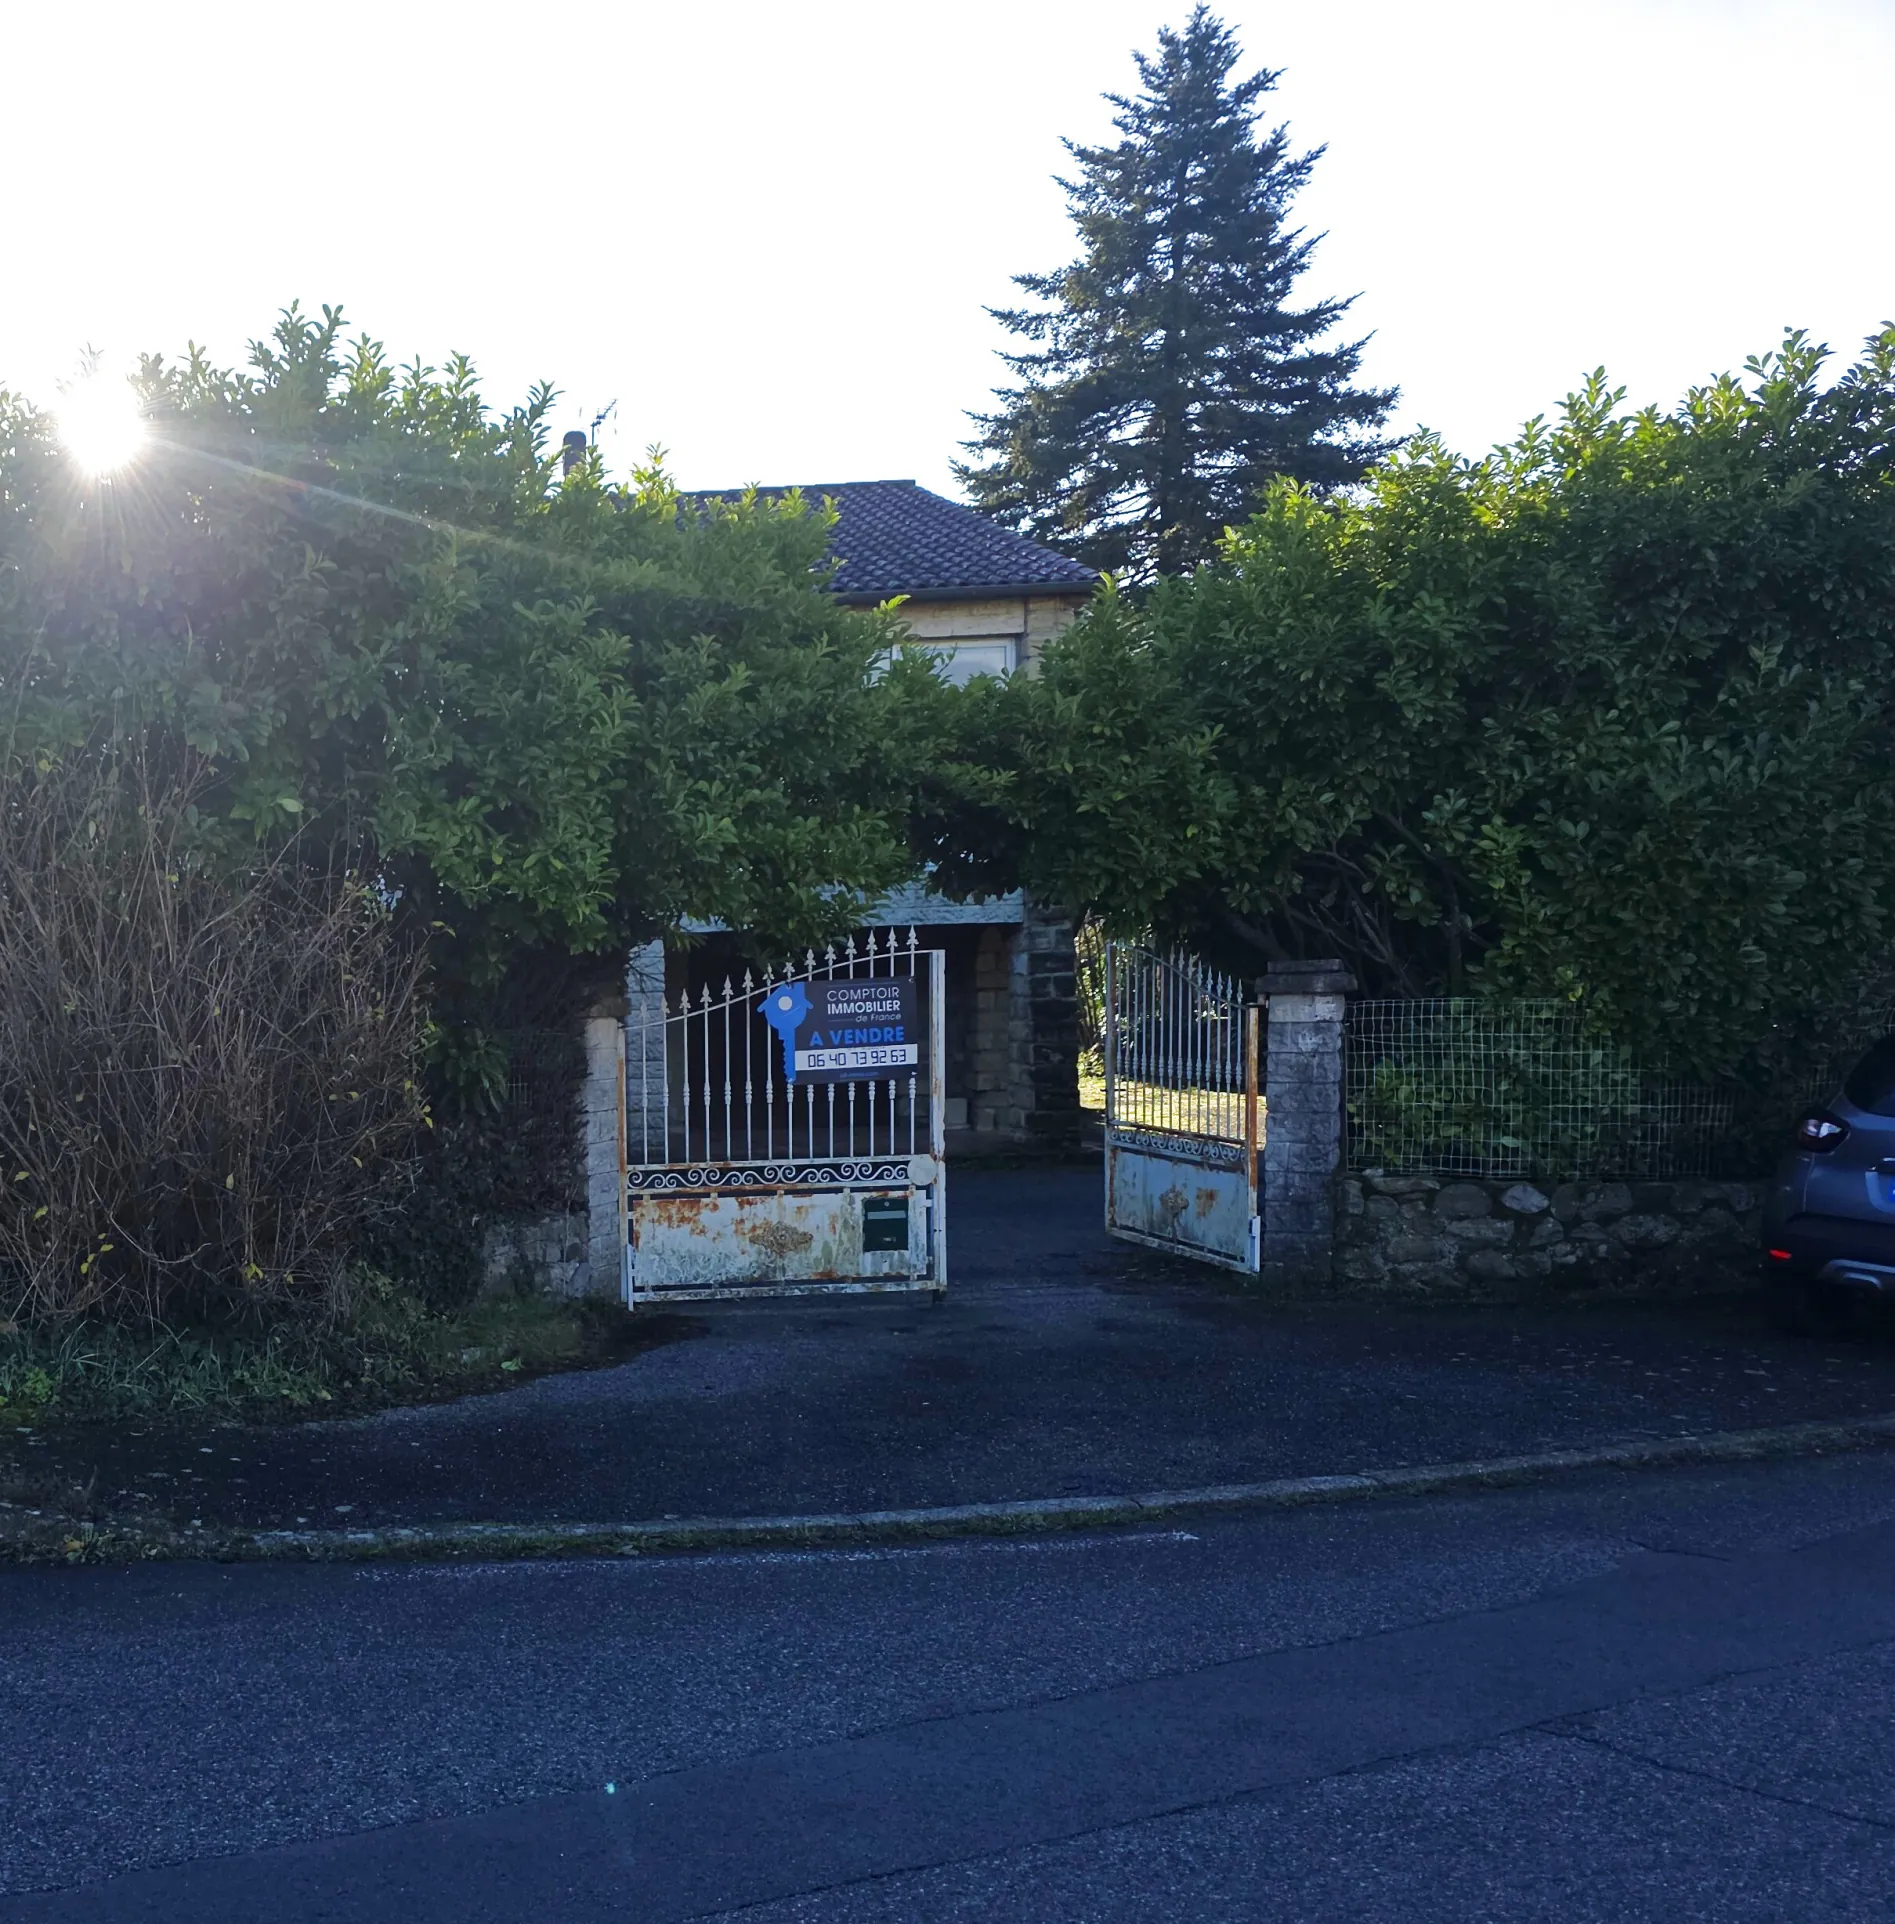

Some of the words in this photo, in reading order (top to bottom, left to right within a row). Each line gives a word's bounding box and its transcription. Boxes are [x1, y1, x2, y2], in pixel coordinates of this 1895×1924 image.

[827, 987, 900, 1001] COMPTOIR
[827, 1000, 901, 1015] IMMOBILIER
[855, 1013, 868, 1023] de
[871, 1013, 901, 1021] France
[810, 1031, 824, 1046] A
[829, 1026, 905, 1046] VENDRE
[808, 1053, 825, 1068] 06
[829, 1052, 847, 1066] 40
[851, 1051, 868, 1065] 73
[871, 1050, 888, 1064] 92
[890, 1049, 907, 1064] 63
